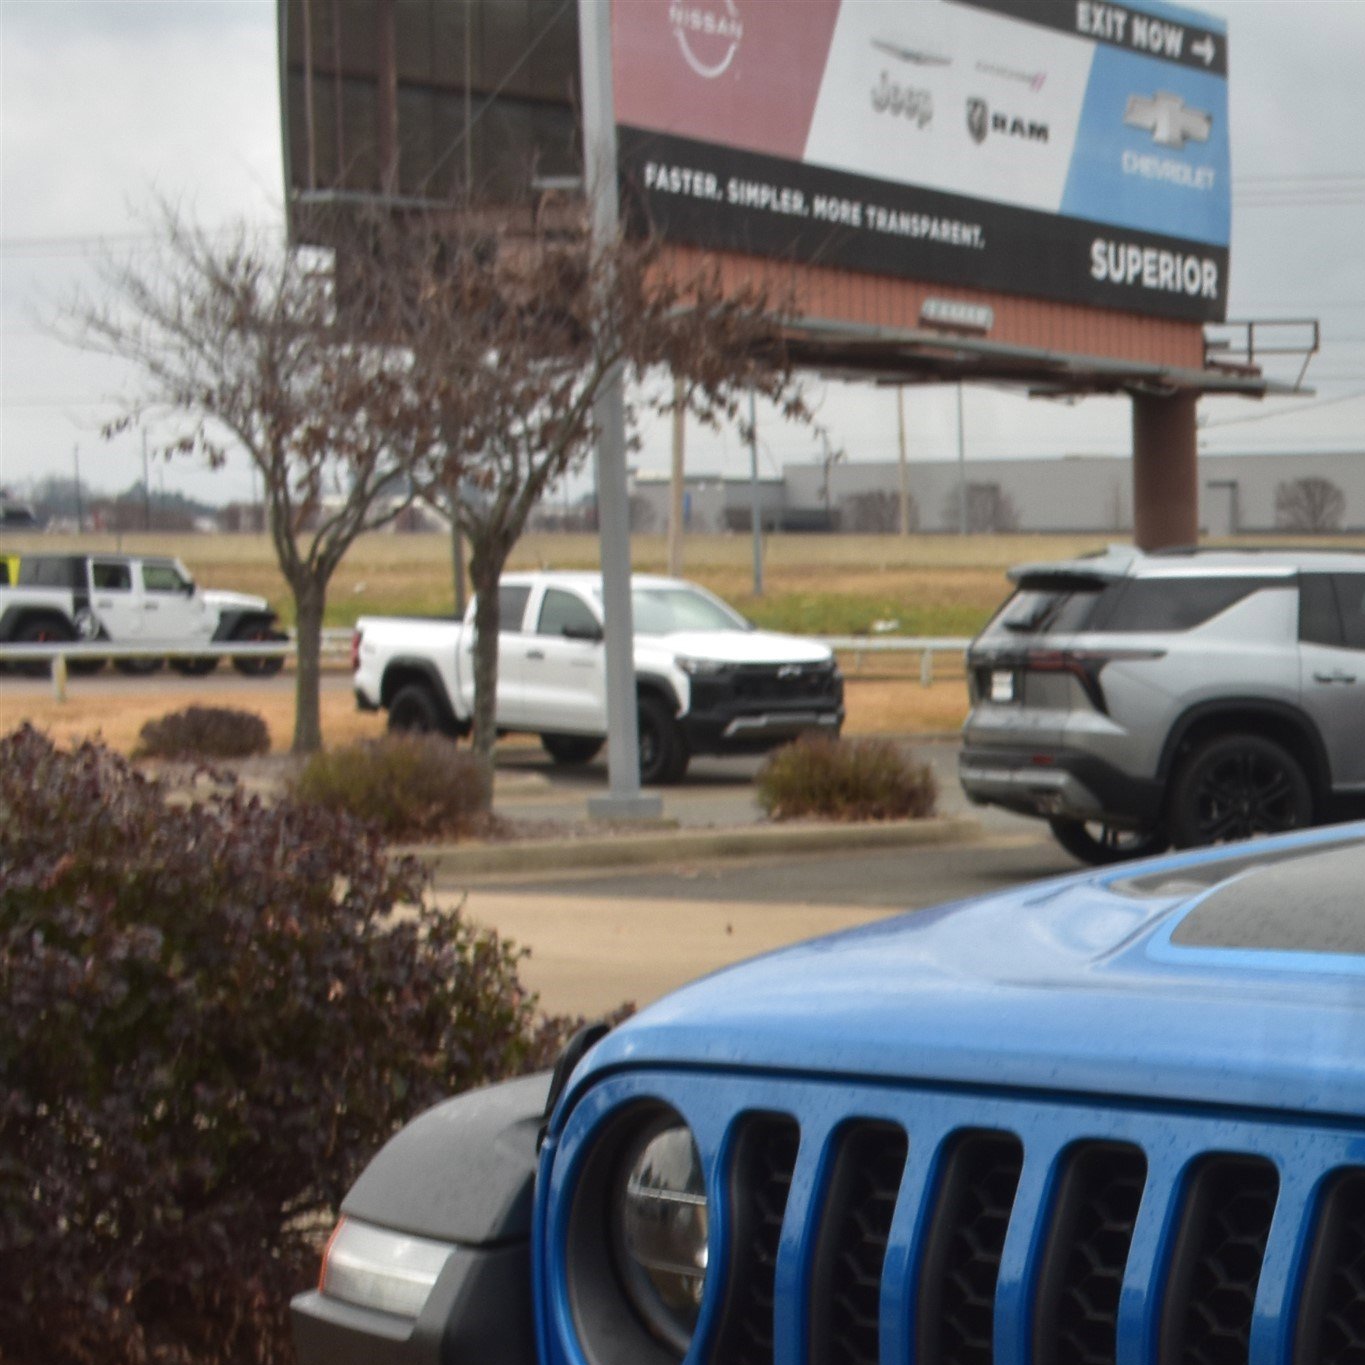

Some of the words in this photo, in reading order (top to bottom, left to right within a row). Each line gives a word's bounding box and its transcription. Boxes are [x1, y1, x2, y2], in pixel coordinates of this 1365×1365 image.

[669, 4, 743, 40] NISSAN
[1076, 1, 1127, 42] EXIT
[1132, 15, 1184, 58] NOW
[992, 112, 1049, 143] RAM
[1121, 150, 1215, 190] CHEVROLET
[813, 195, 862, 227] MORE
[866, 204, 985, 249] TRANSPARENT.
[1090, 238, 1218, 299] SUPERIOR
